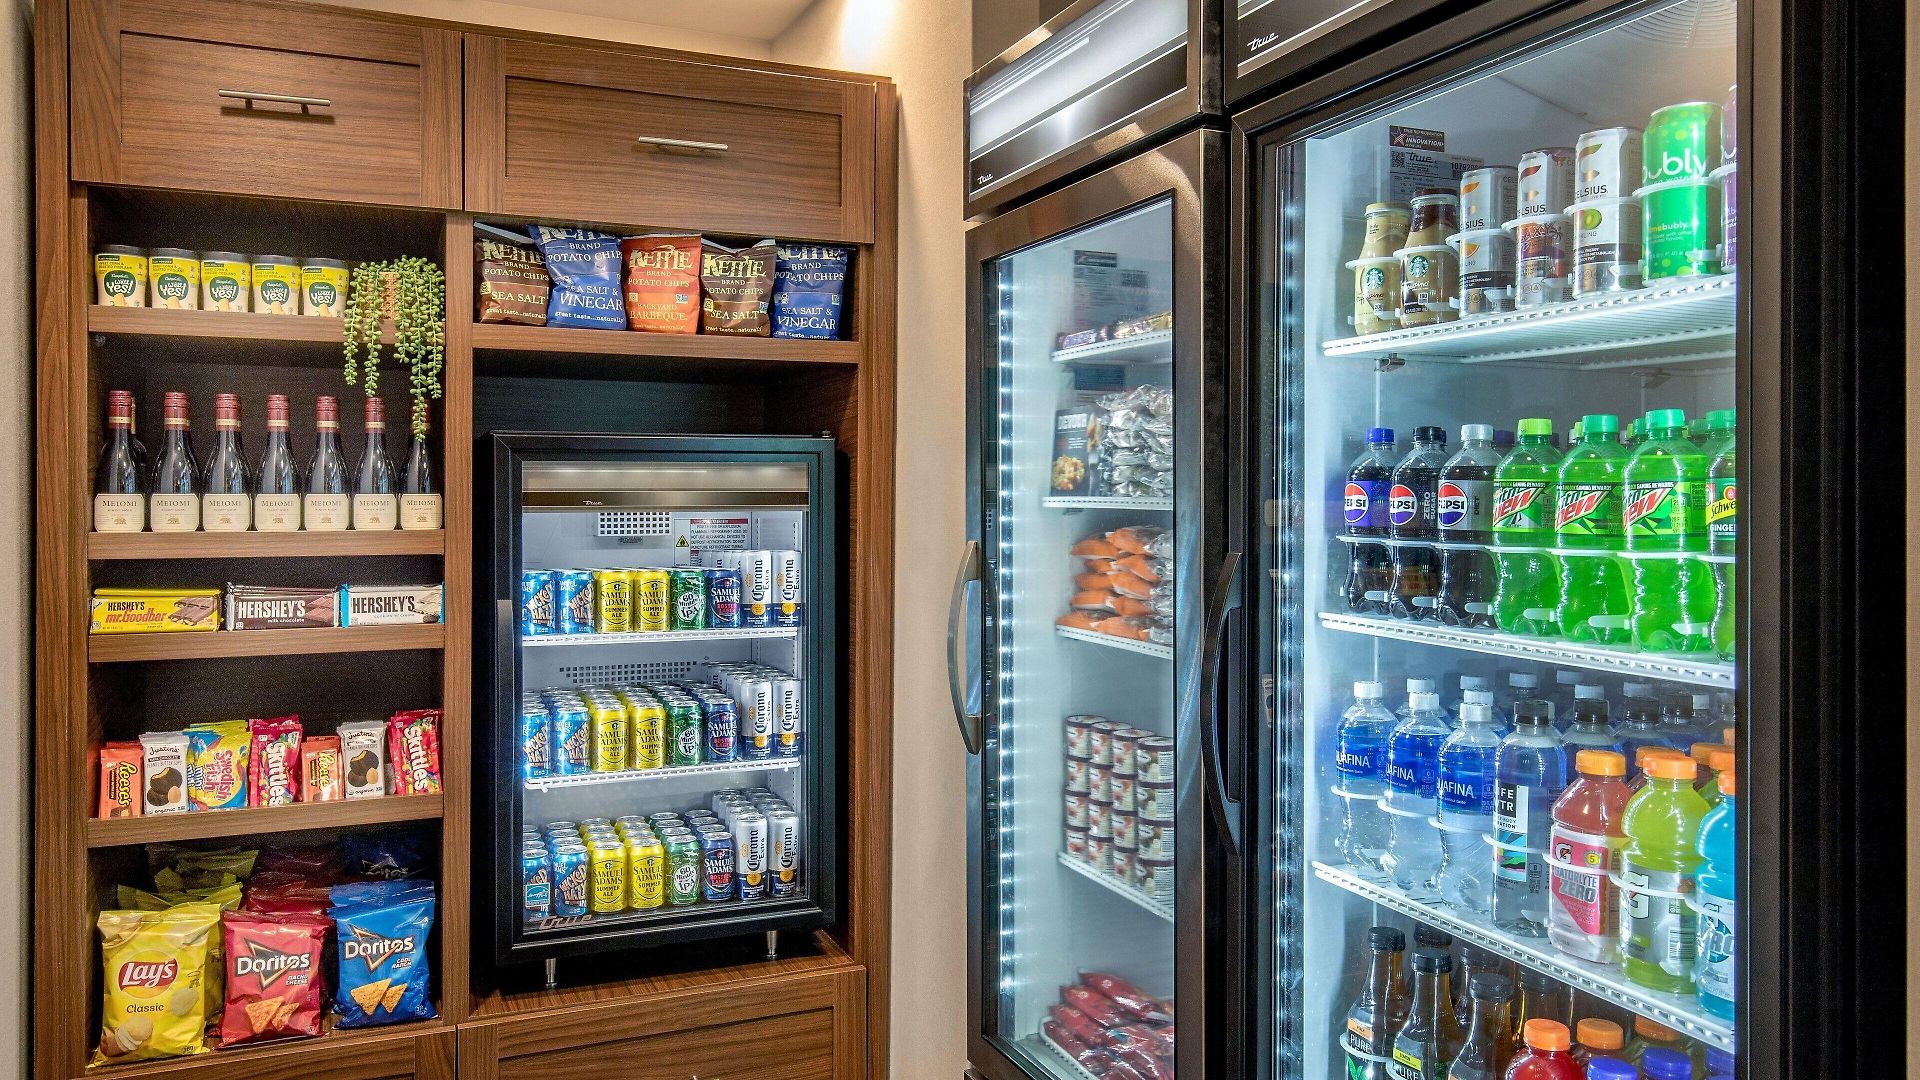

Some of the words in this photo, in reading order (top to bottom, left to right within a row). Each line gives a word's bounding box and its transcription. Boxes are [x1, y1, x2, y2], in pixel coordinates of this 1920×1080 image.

[1576, 184, 1608, 198] ELSIUS
[569, 242, 601, 250] BRAND
[548, 254, 591, 262] POTATO
[702, 254, 766, 277] KETTLE
[792, 262, 821, 270] BRAND
[484, 269, 520, 277] POTATO
[523, 273, 549, 281] CHIPS
[775, 272, 810, 282] POTATO
[814, 272, 843, 281] CHIPS
[492, 291, 514, 300] SEA
[518, 293, 546, 304] SALT
[587, 286, 609, 294] SALT
[612, 288, 618, 296] &
[560, 293, 622, 311] VINEGAR
[630, 310, 684, 322] BARBEQUE
[711, 311, 729, 320] SEA
[733, 310, 759, 319] SALT
[777, 317, 835, 330] VINEGAR
[1711, 500, 1736, 519] Schwe
[752, 559, 764, 601] Corona
[782, 559, 794, 600] Corona
[711, 588, 740, 596] SAMUEL
[108, 601, 144, 611] HERSHEY'S
[238, 600, 306, 618] HERSHEY'S
[352, 596, 415, 614] HERSHEY'S
[755, 692, 767, 733] Corona
[782, 690, 795, 731] Corona
[711, 729, 736, 738] ADAMS
[150, 746, 179, 755] Justin's
[405, 726, 430, 792] Skittles
[267, 743, 288, 807] Skittles
[118, 761, 138, 806] Reese's
[747, 830, 760, 871] Corona
[781, 827, 792, 868] Corona
[1590, 855, 1595, 863] 5
[593, 868, 623, 877] SAMUEL
[680, 866, 690, 874] 60
[595, 877, 622, 885] ADAMS
[637, 873, 663, 883] ADAMS
[1560, 880, 1597, 902] ZERO
[345, 936, 414, 958] Doritos
[237, 953, 310, 975] Doritos
[122, 961, 176, 988] Lay's
[285, 978, 308, 986] CHEESE
[126, 1004, 164, 1014] Classic
[1350, 1034, 1370, 1053] PURE
